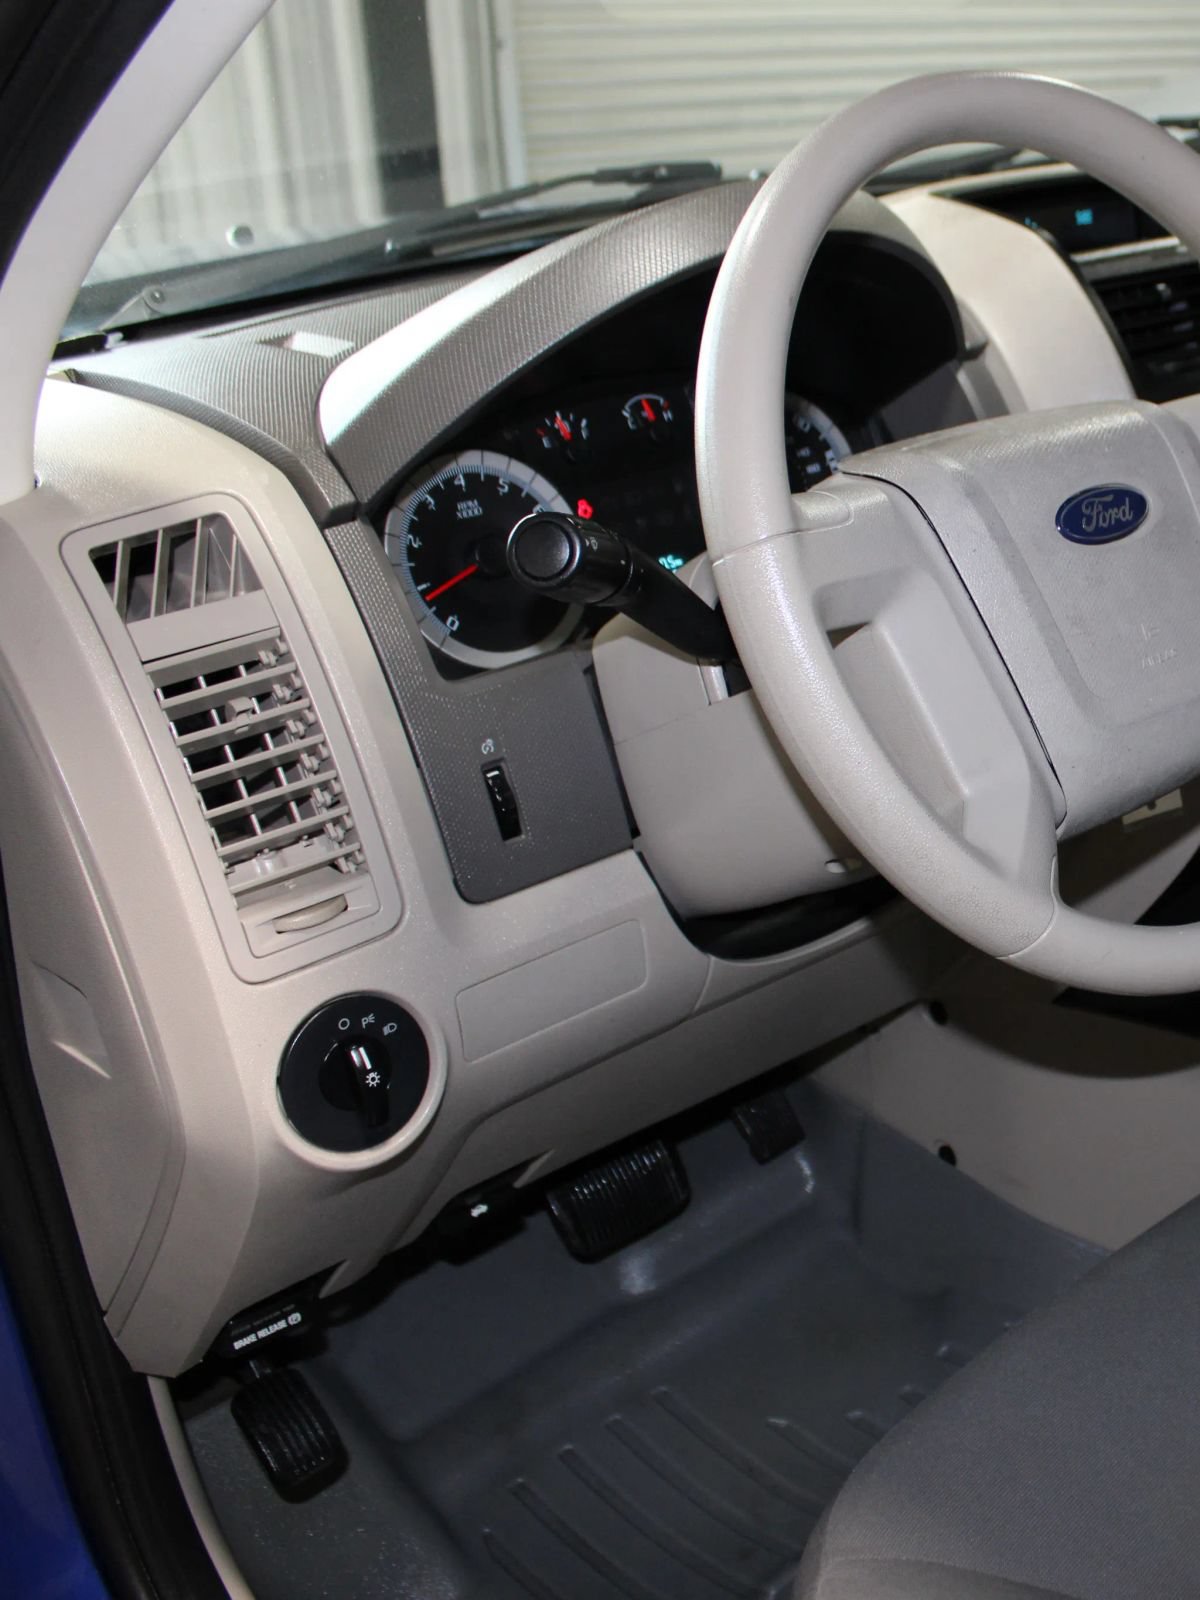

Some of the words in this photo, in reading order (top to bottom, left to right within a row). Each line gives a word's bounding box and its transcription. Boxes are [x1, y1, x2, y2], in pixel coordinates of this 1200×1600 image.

[453, 473, 467, 492] 4
[497, 478, 510, 496] 5
[423, 493, 437, 511] 3
[1081, 494, 1134, 532] Ford
[407, 533, 423, 549] 2
[446, 614, 460, 632] 0
[233, 1333, 258, 1350] BRAKE
[256, 1319, 289, 1339] RELEASE
